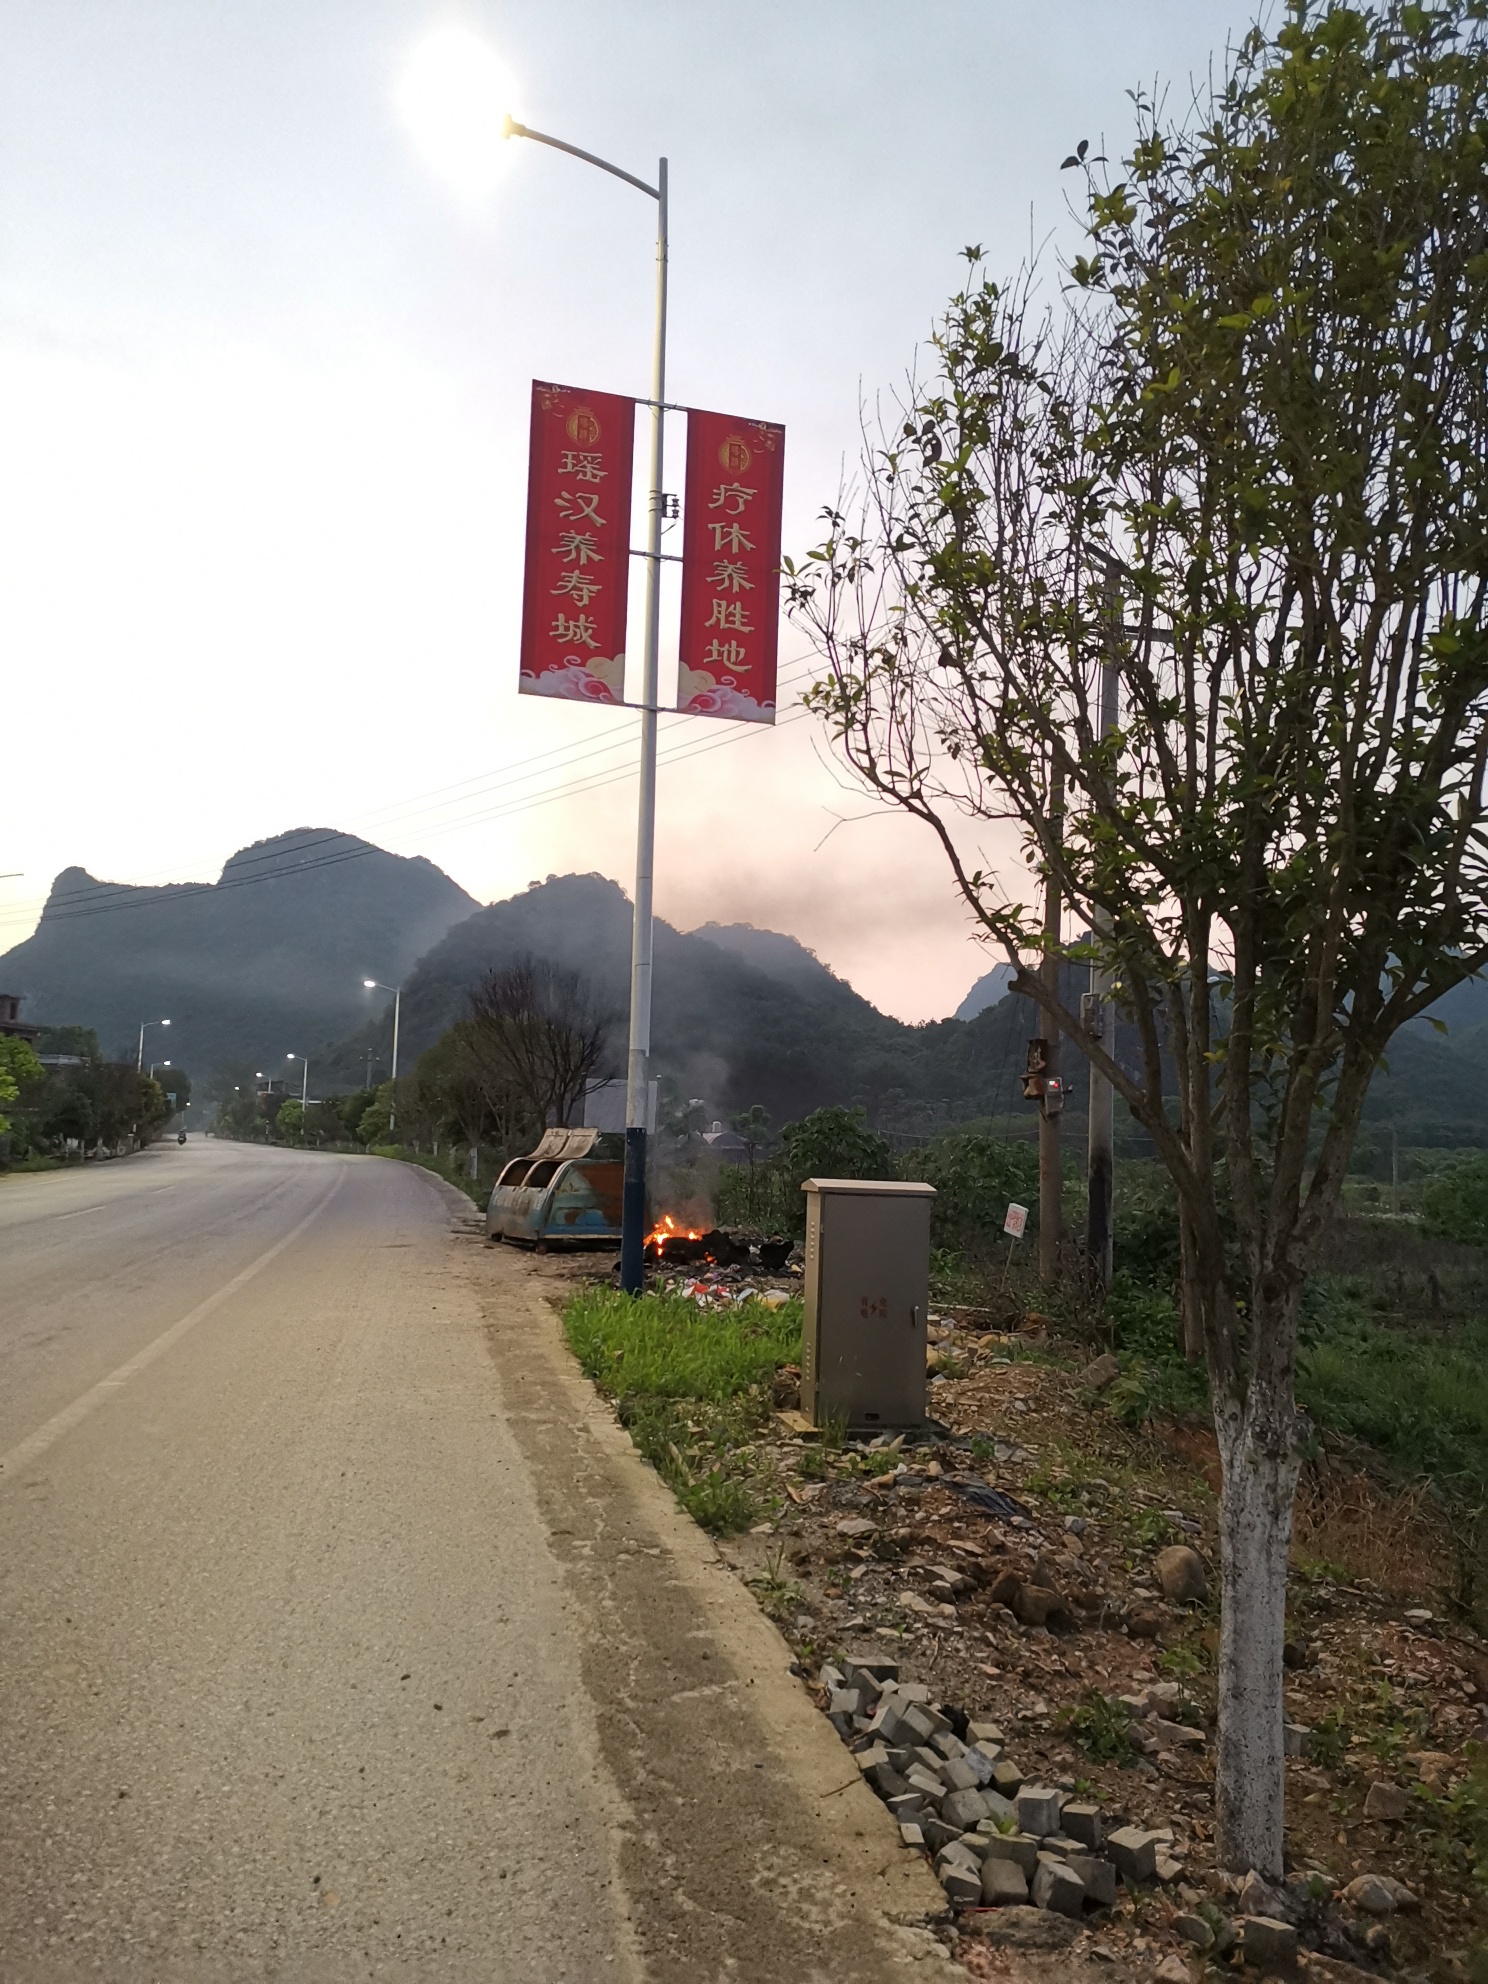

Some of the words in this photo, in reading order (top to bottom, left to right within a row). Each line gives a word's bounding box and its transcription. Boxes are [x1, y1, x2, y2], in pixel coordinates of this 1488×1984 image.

[549, 450, 608, 649] 瑶汉养寿城
[703, 482, 758, 673] 疗休养胜地
